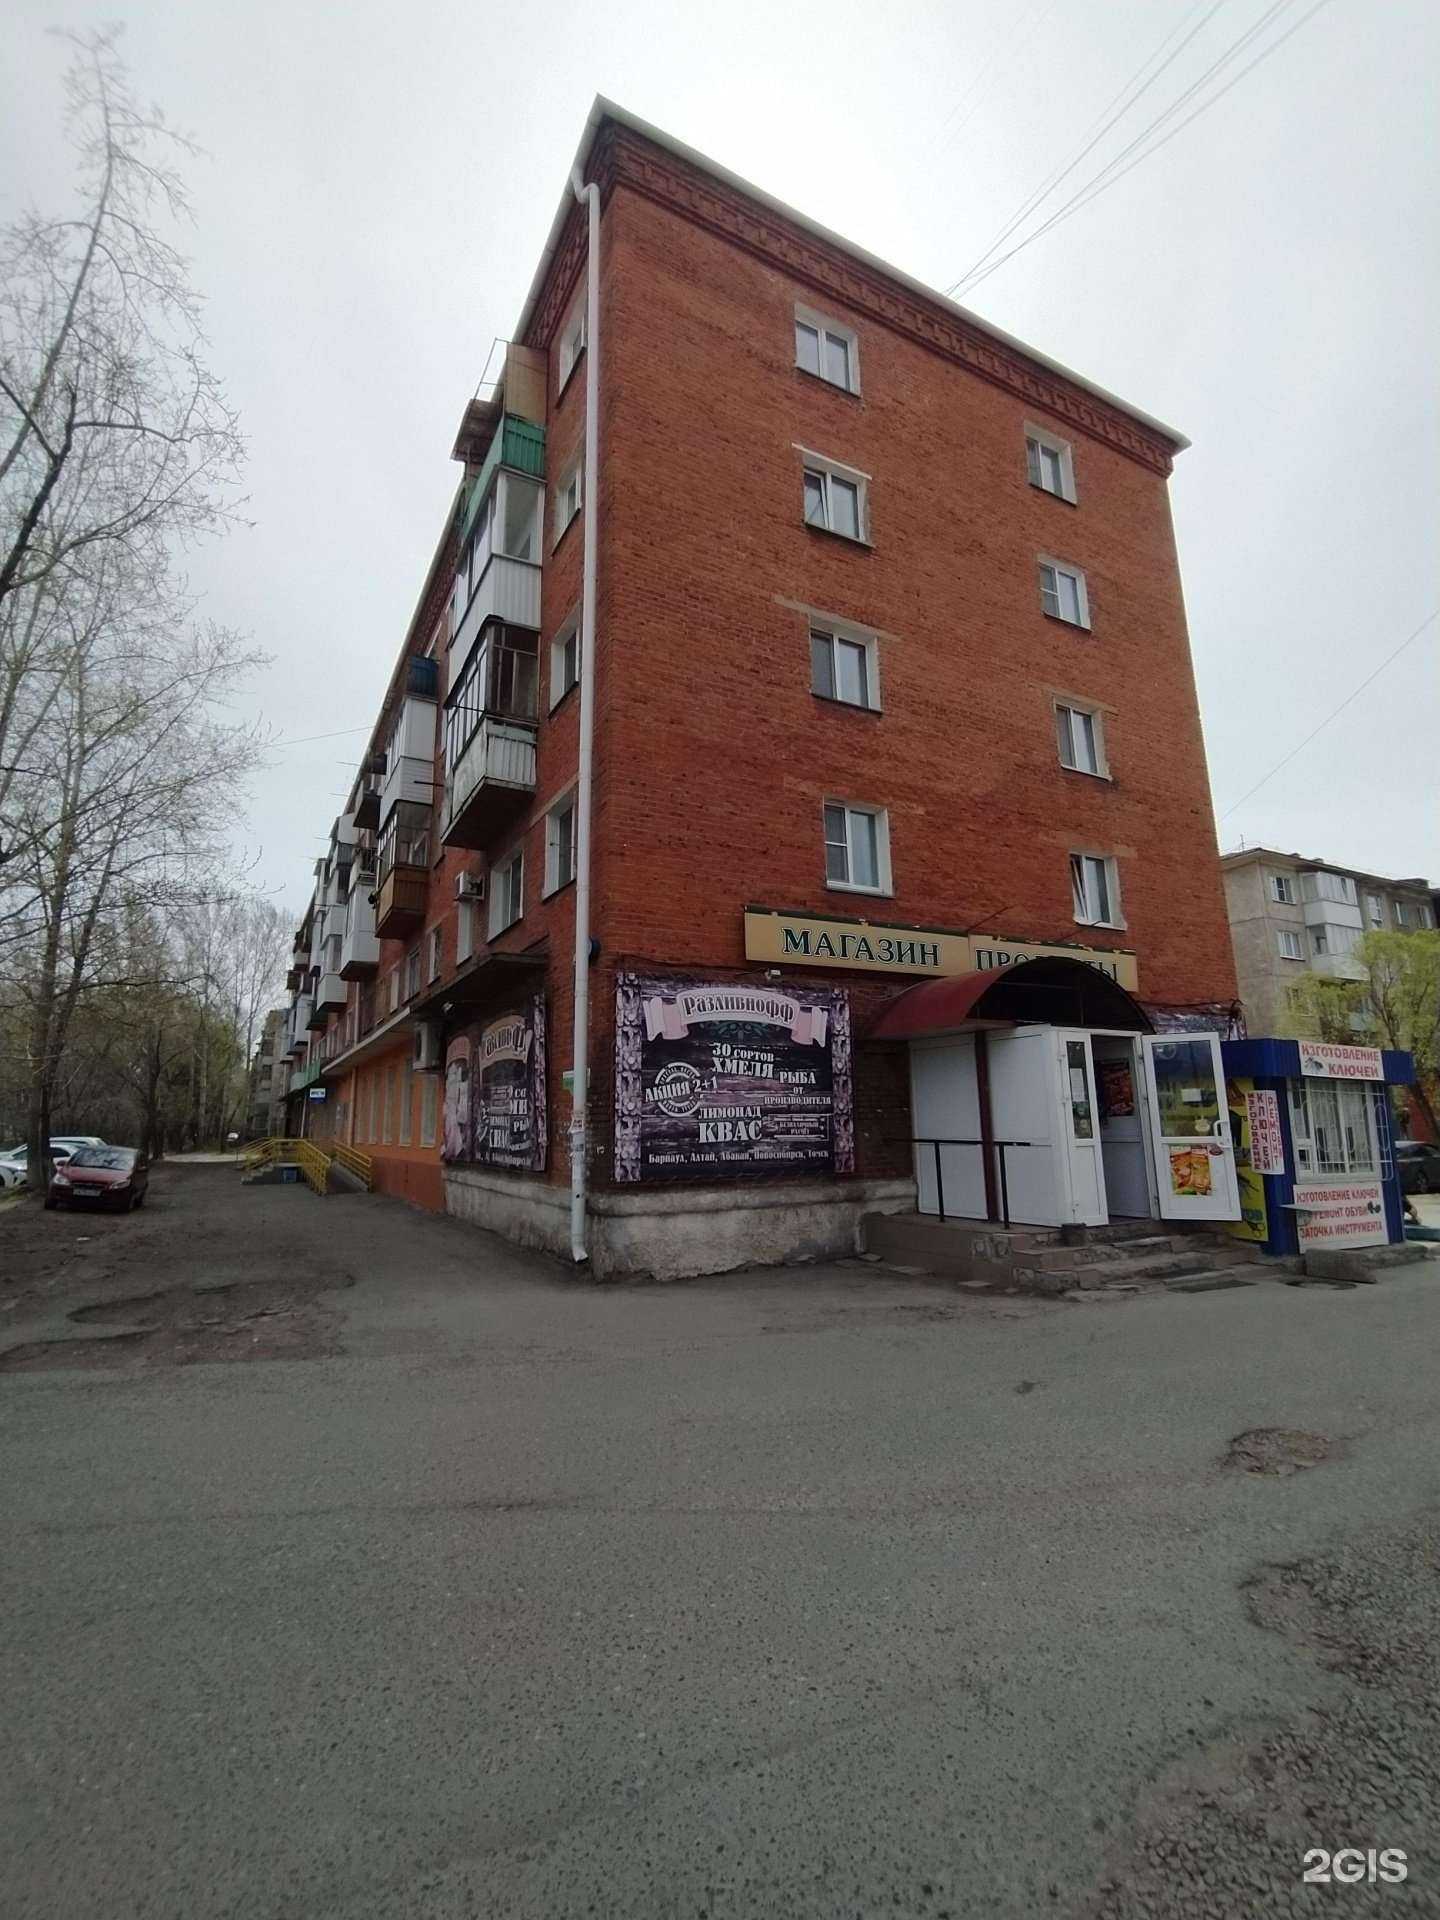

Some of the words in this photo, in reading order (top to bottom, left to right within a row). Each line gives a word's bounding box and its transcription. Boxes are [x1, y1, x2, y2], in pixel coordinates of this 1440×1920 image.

[781, 928, 942, 967] МАГАЗИН
[712, 1042, 731, 1056] 30
[733, 1048, 774, 1062] СОРТОВ
[1302, 1043, 1380, 1061] ИЗГОТОВЛЕНИЕ
[711, 1057, 774, 1078] ХМЕЛЯ
[1328, 1062, 1379, 1078] КЛЮЧЕЙ
[779, 1071, 816, 1084] РЫБА
[645, 1081, 691, 1103] АКЦИЯ
[692, 1075, 718, 1093] 2+1
[764, 1096, 831, 1105] ПРОИЗВОДИТЕЛЯ
[698, 1106, 762, 1119] ЛИМОНАД
[698, 1120, 762, 1143] КВАС
[1297, 1189, 1351, 1204] ИЗГОТОВЛЕНИЕ
[1300, 1223, 1333, 1239] ЗАТОЧКА
[1335, 1220, 1383, 1236] ИНСТРУМЕНТА
